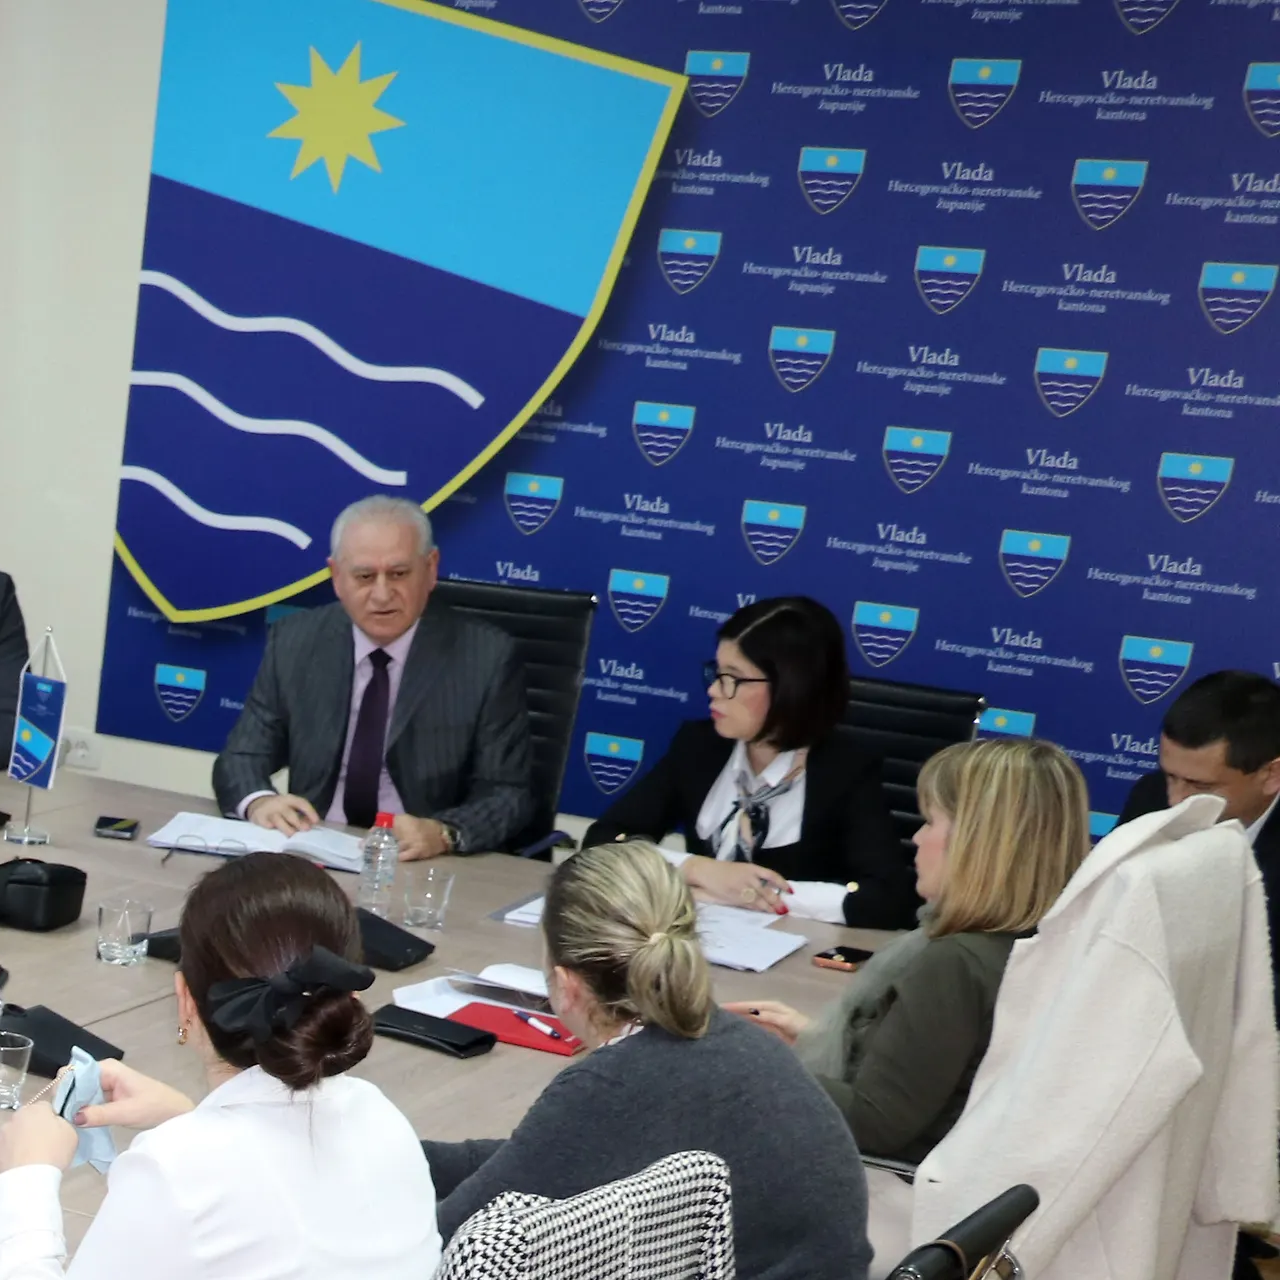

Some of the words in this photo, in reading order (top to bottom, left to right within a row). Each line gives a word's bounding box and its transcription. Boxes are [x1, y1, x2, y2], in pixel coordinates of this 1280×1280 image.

[824, 63, 874, 82] Vlada
[1101, 70, 1158, 90] Vlada
[818, 98, 866, 114] županije
[1096, 108, 1147, 121] kantona
[675, 149, 722, 167] Vlada
[941, 162, 994, 181] Vlada
[1231, 173, 1280, 193] Vlad
[936, 198, 986, 213] županije
[1165, 193, 1280, 210] Hercegovačko-ner
[1224, 210, 1279, 224] kantona
[793, 246, 842, 265] Vlada
[1062, 263, 1116, 284] Vlada
[788, 280, 836, 296] županije
[1057, 299, 1106, 313] kantona
[647, 324, 695, 343] Vlada
[645, 355, 688, 370] kantona
[908, 345, 960, 367] Vlada
[1187, 368, 1244, 388] Vlada
[904, 381, 952, 397] županije
[1181, 403, 1233, 418] kantona
[763, 422, 812, 443] Vlada
[759, 455, 806, 471] županije
[1026, 448, 1078, 470] Vlada
[1021, 482, 1069, 498] kantona
[624, 493, 670, 514] Vlada
[621, 525, 662, 540] kantona
[877, 523, 927, 545] Vlada
[496, 561, 540, 582] Vlada
[872, 557, 919, 574] županije
[1148, 554, 1202, 576] Vlada
[1142, 587, 1191, 604] kantona
[991, 627, 1043, 649] Vlada
[599, 658, 644, 680] Vlada
[987, 659, 1034, 676] kantona
